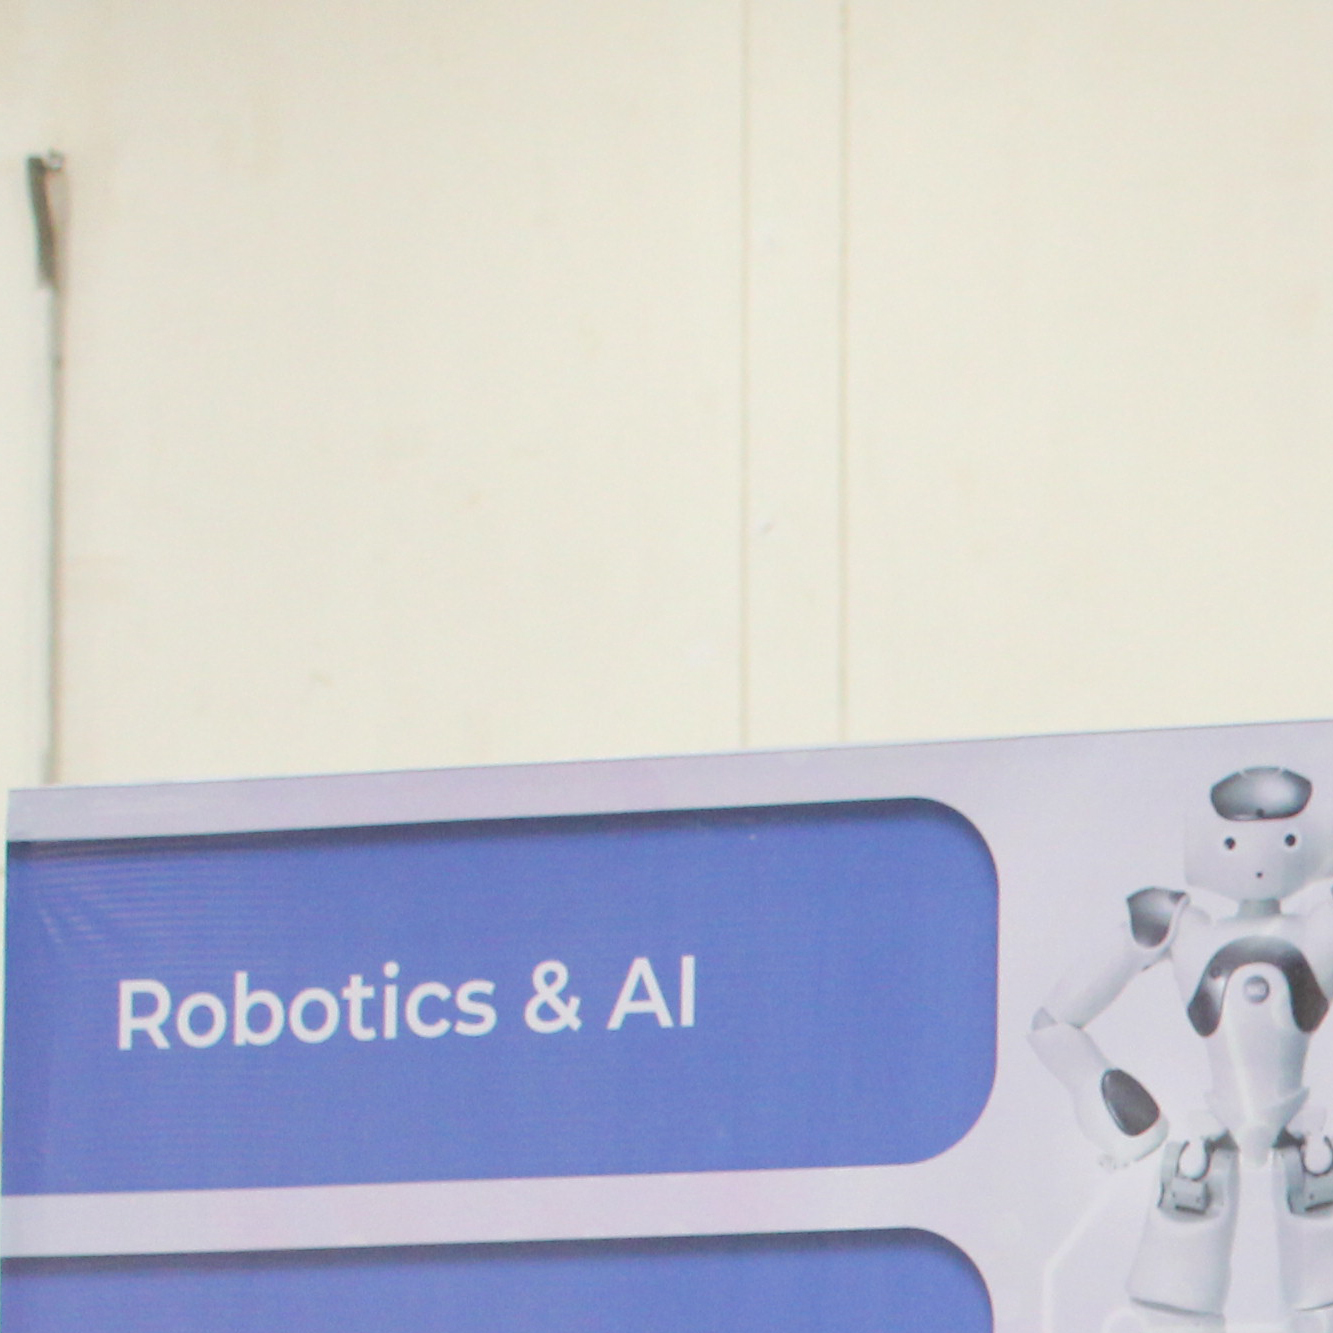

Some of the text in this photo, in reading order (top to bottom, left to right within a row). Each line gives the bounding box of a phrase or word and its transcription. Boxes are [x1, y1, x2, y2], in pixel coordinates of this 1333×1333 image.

[117, 954, 695, 1050] Robotics & AI
